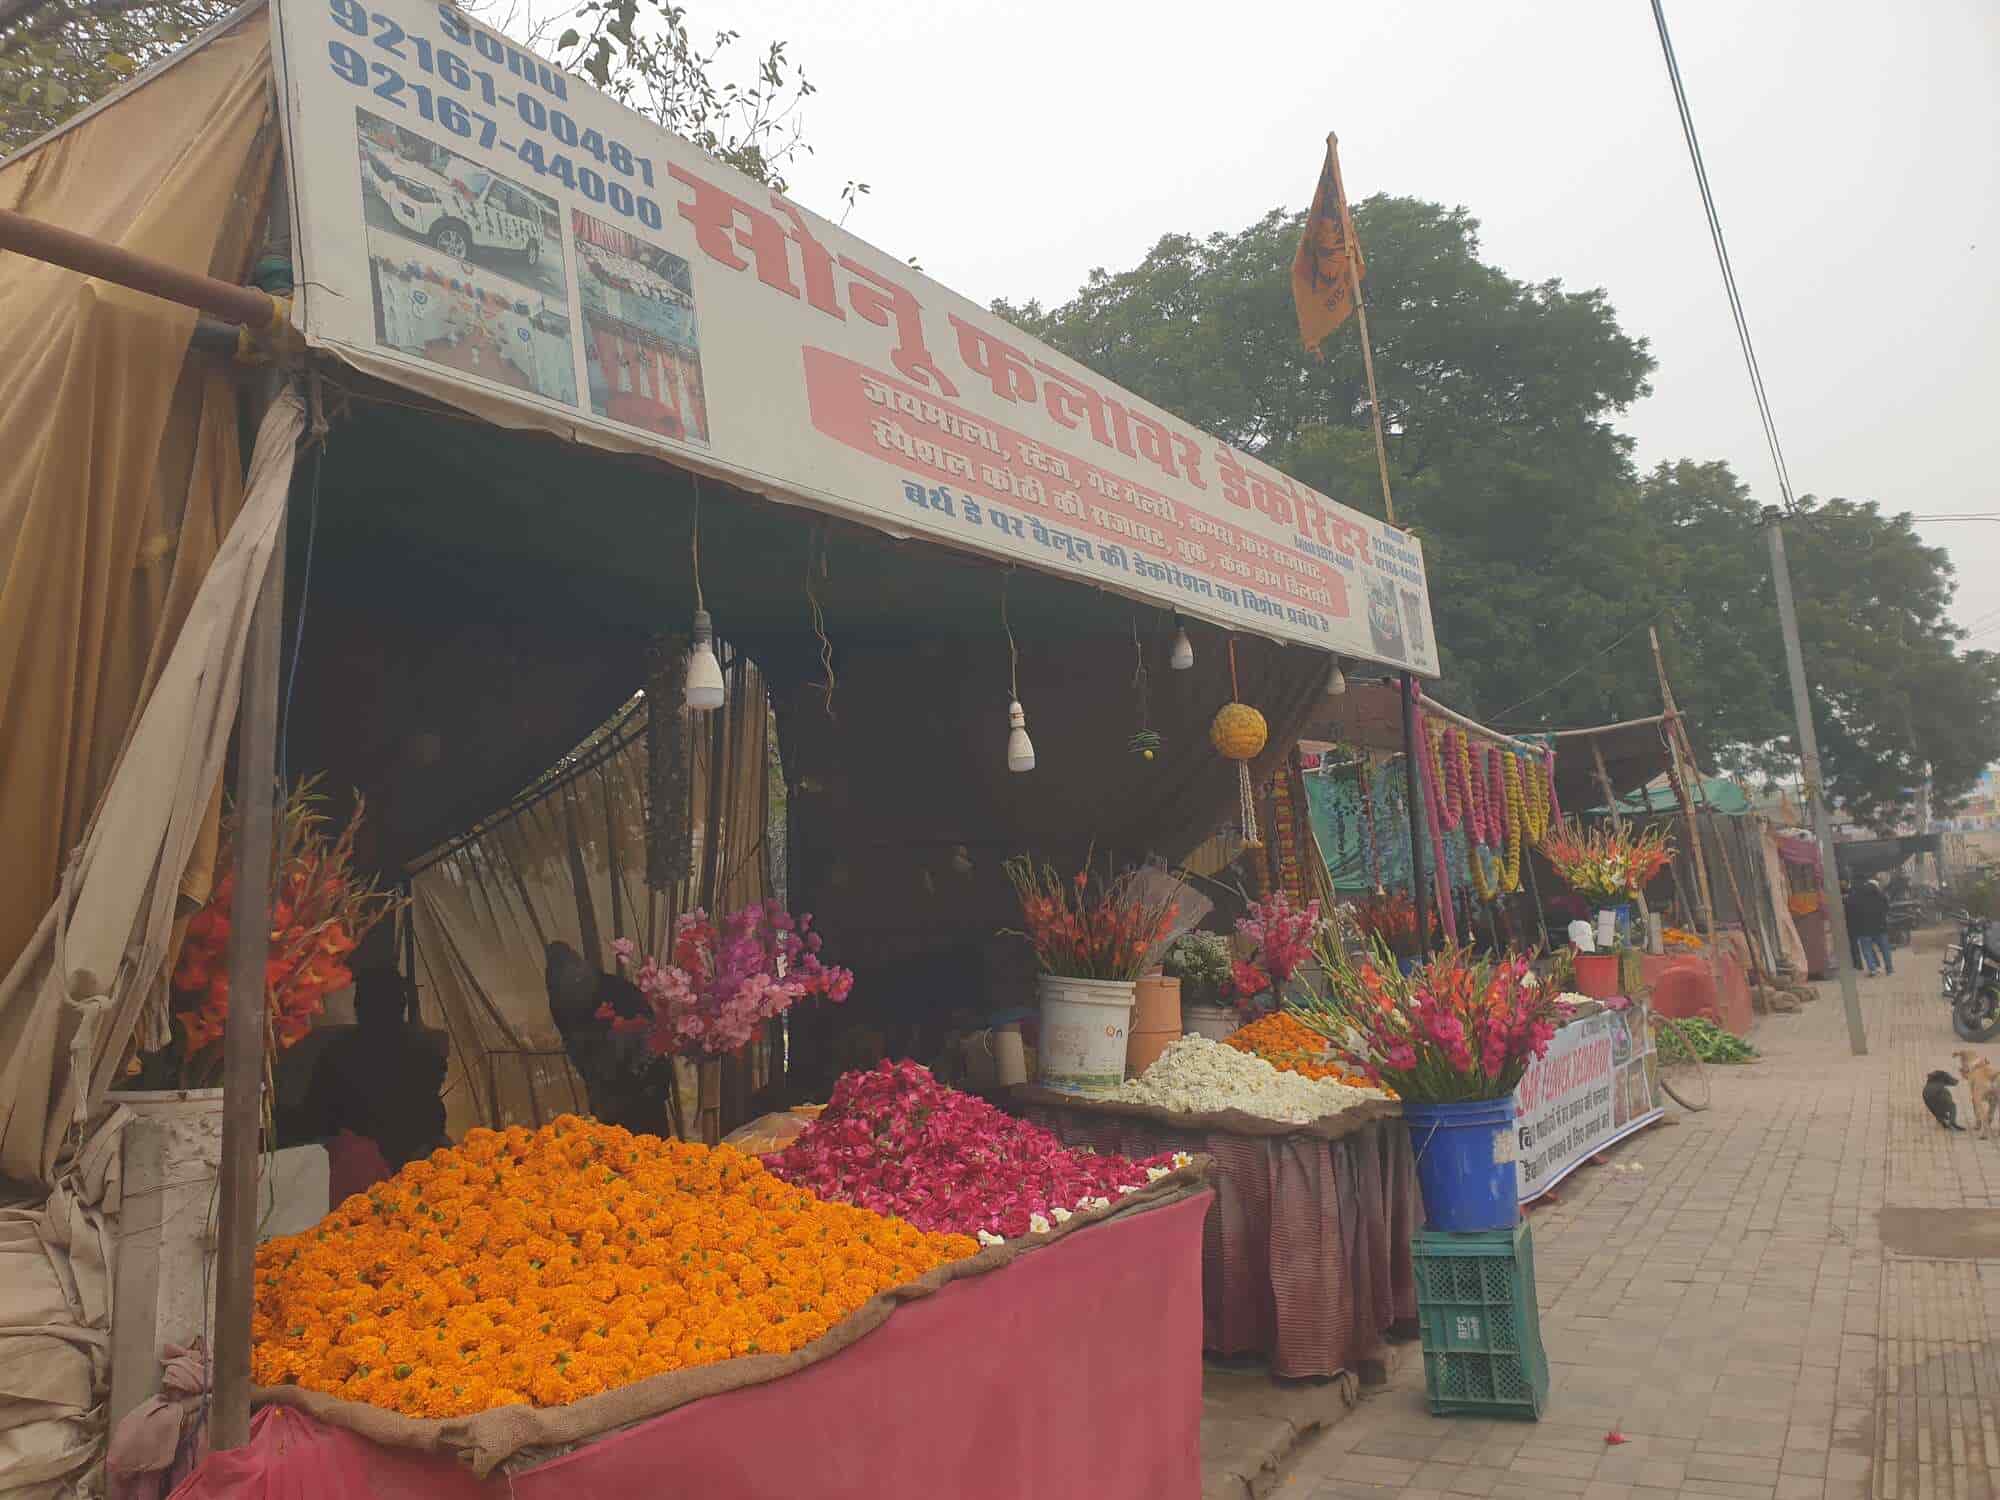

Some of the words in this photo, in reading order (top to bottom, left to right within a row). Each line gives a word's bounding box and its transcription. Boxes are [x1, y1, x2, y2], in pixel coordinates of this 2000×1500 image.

[328, 0, 655, 189] 92161-00481
[328, 40, 663, 231] 92167-44000
[438, 3, 568, 102] Sonu
[666, 160, 961, 398] सोनू
